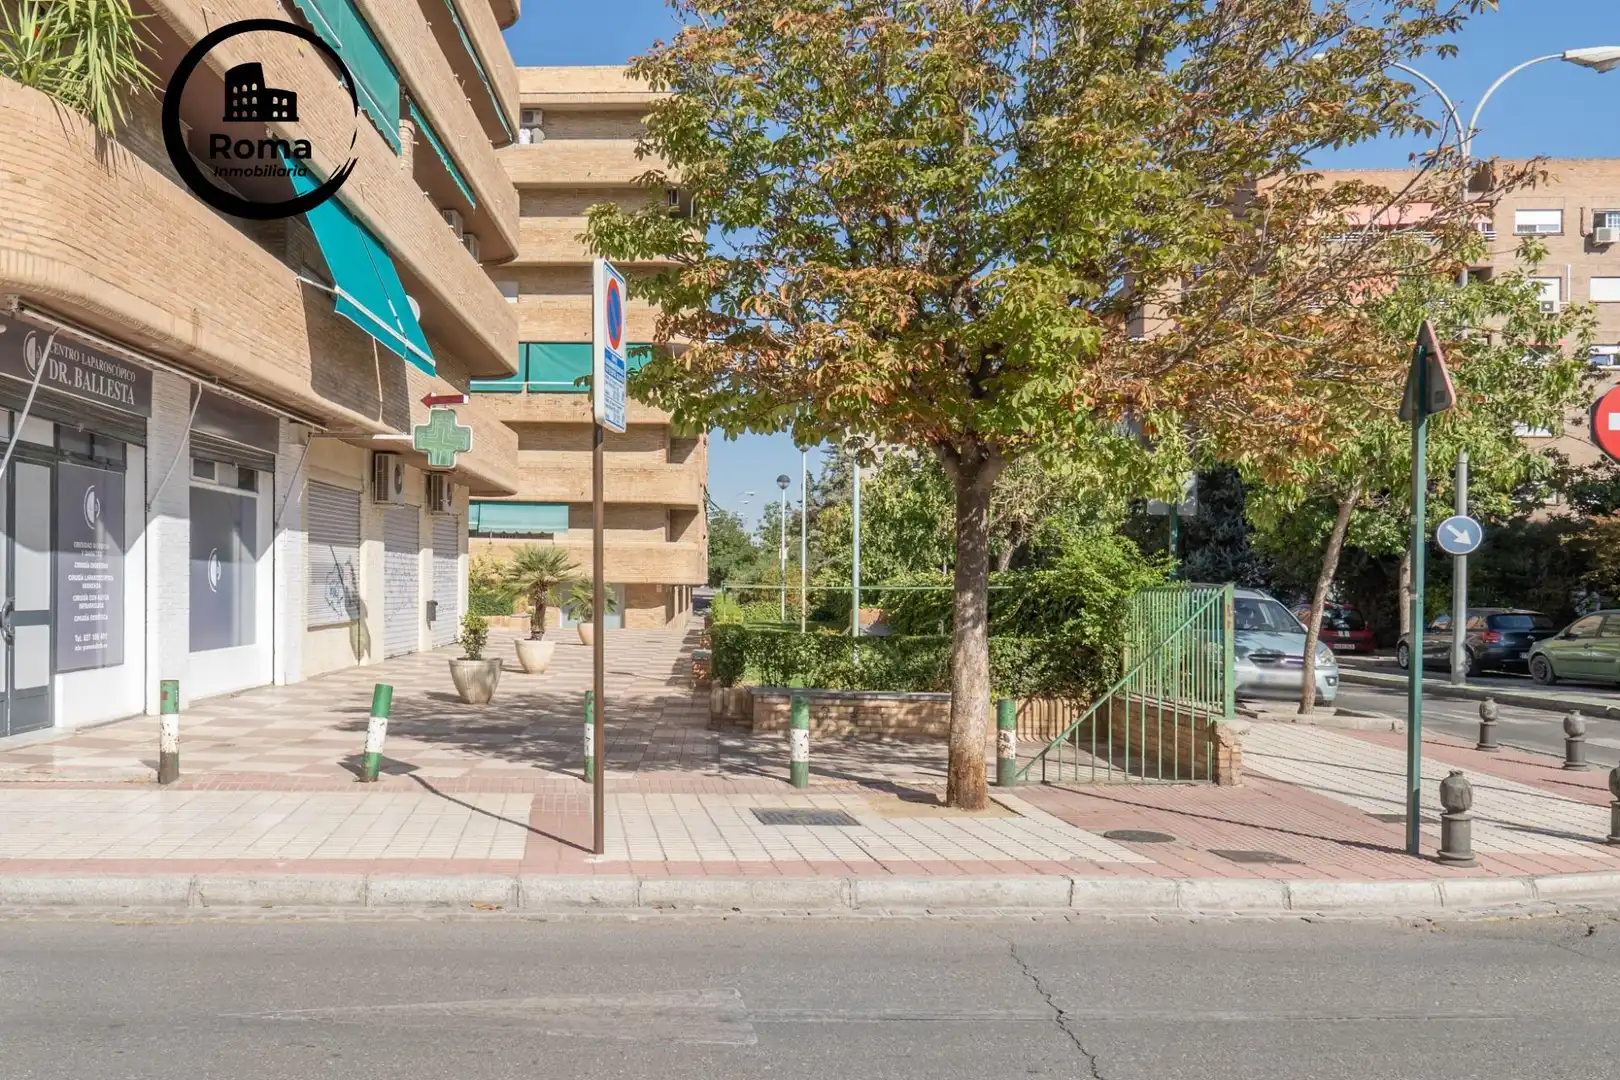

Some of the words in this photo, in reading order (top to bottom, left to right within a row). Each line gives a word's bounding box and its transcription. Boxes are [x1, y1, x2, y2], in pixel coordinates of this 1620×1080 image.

[48, 358, 72, 386] DR.
[74, 366, 135, 405] BALLESTA
[81, 353, 136, 383] LAPAROSCÓPICO
